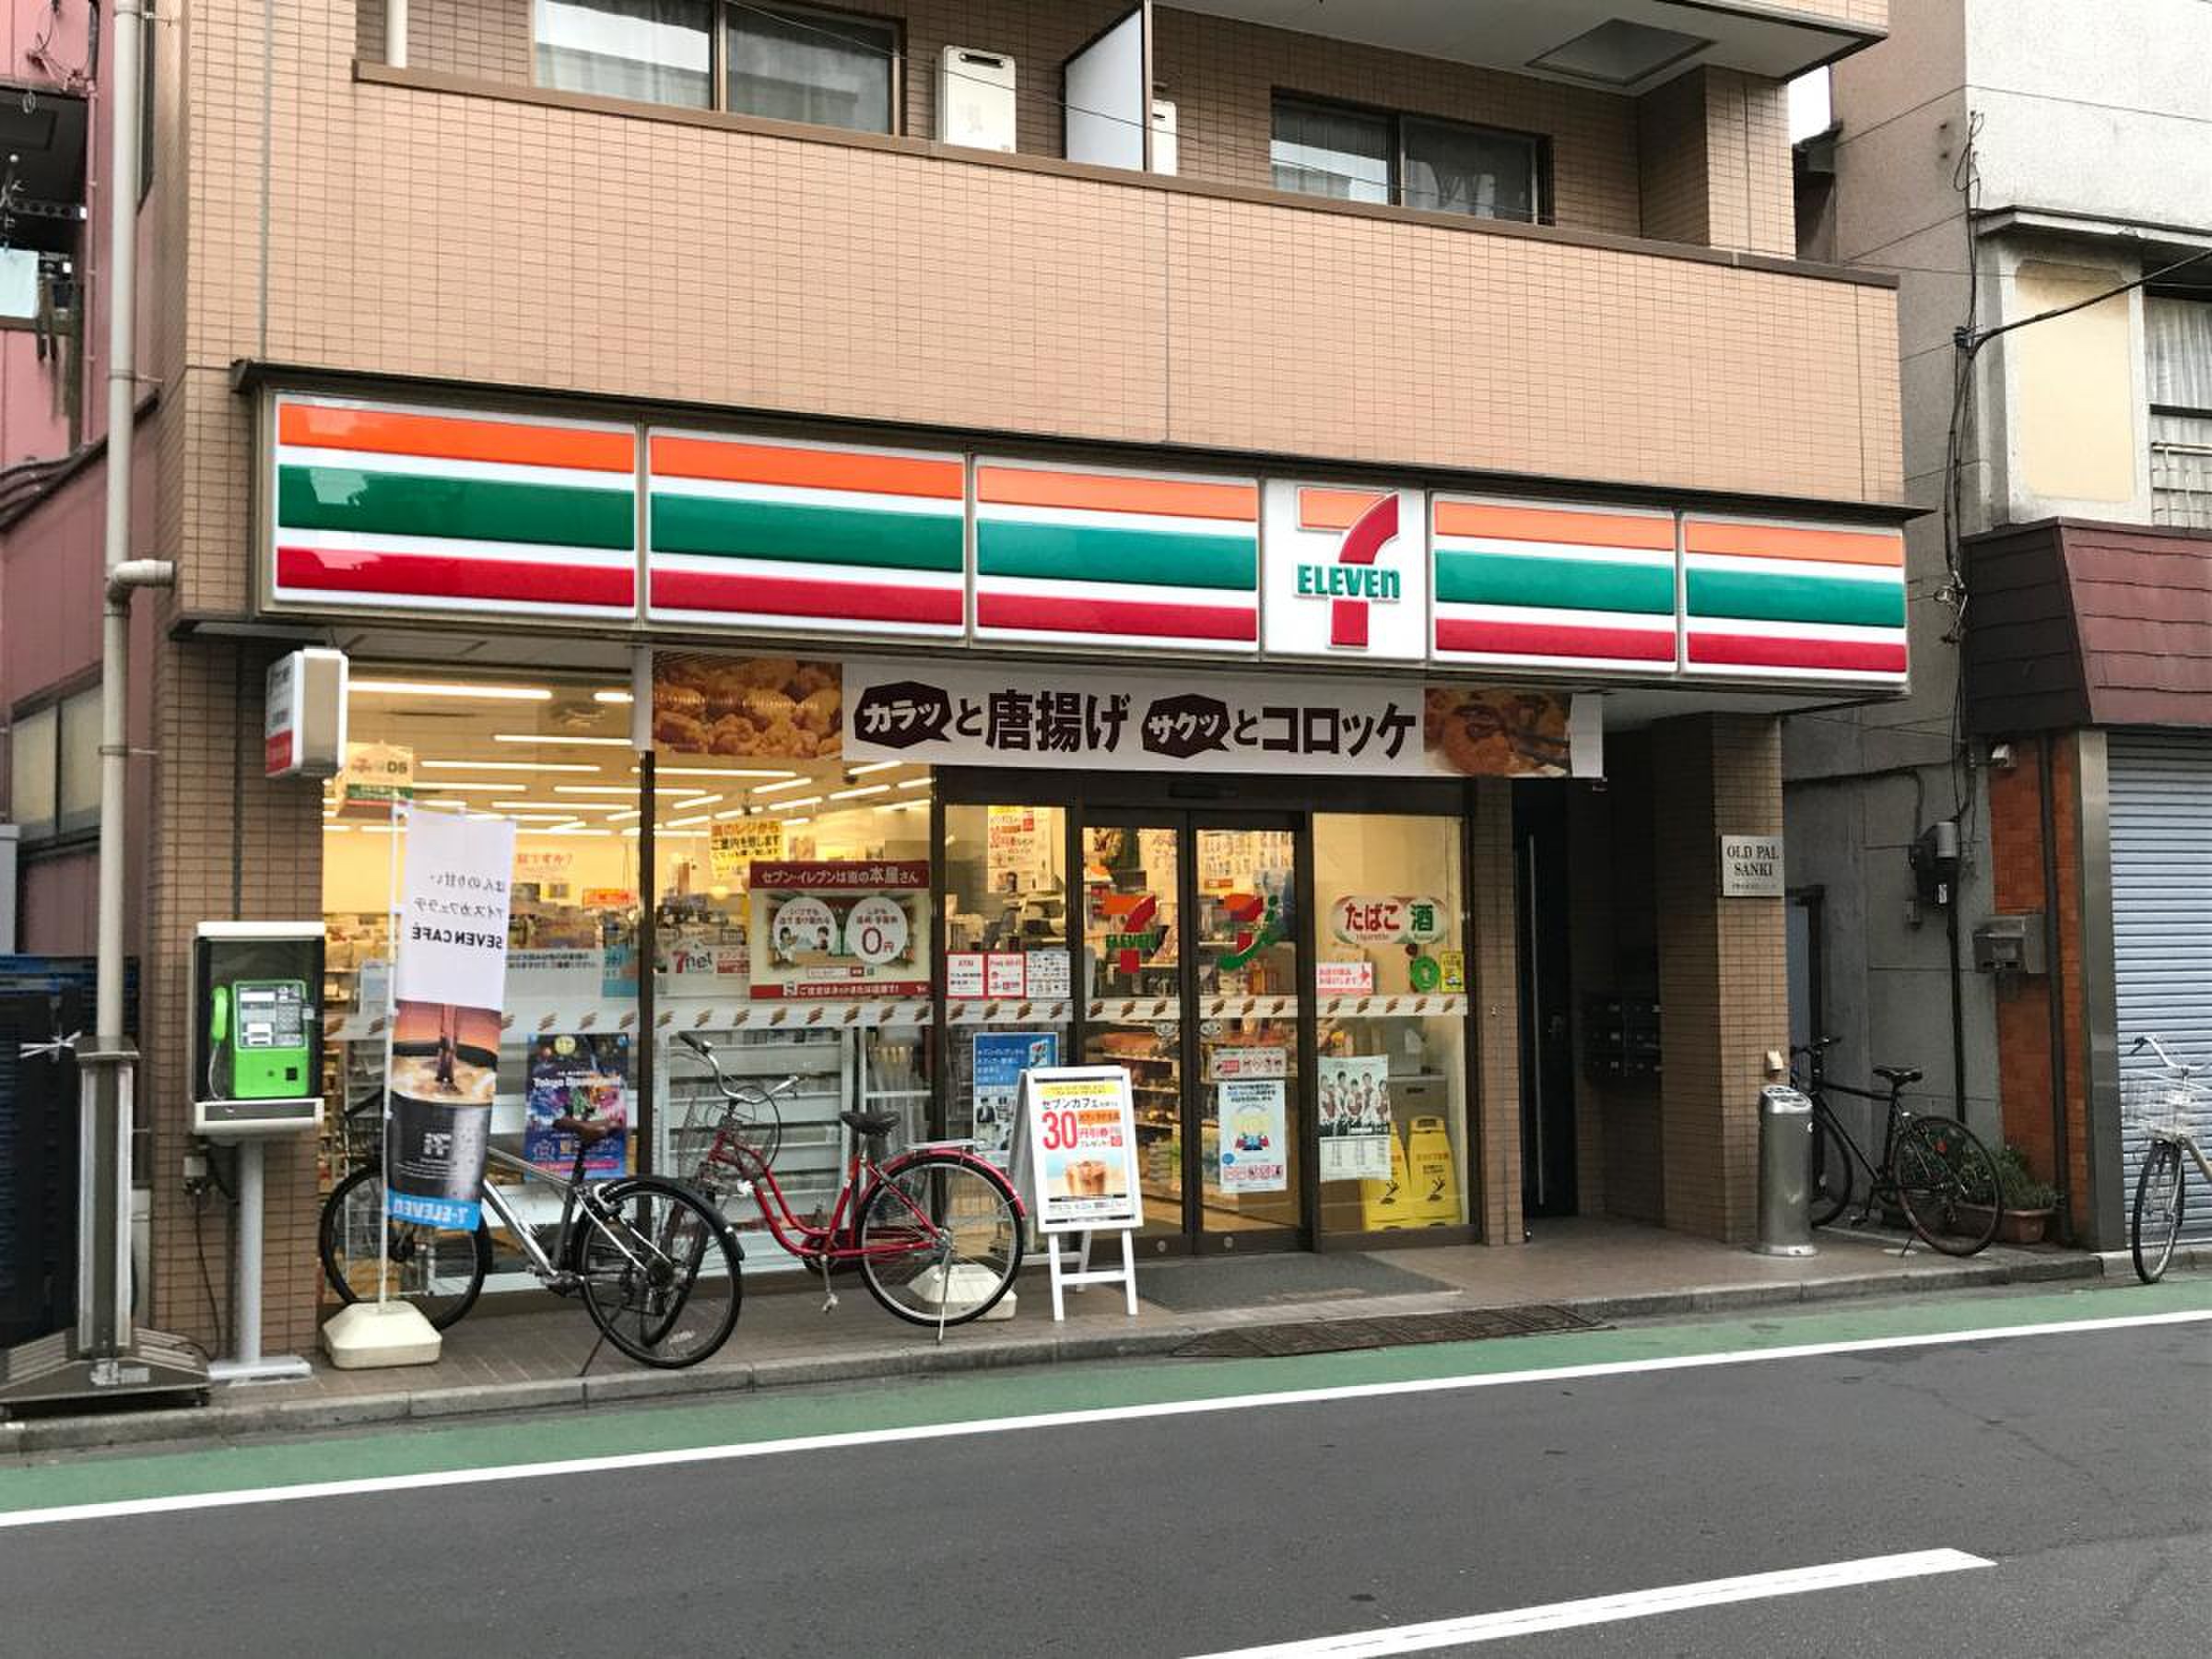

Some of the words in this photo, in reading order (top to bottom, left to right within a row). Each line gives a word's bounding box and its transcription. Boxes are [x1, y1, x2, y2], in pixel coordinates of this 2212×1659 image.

[1726, 844, 1753, 859] OLD
[1756, 845, 1780, 860] PAL
[1733, 862, 1773, 877] SANKI
[1345, 902, 1400, 931] たばこ
[1410, 903, 1433, 932] 酒
